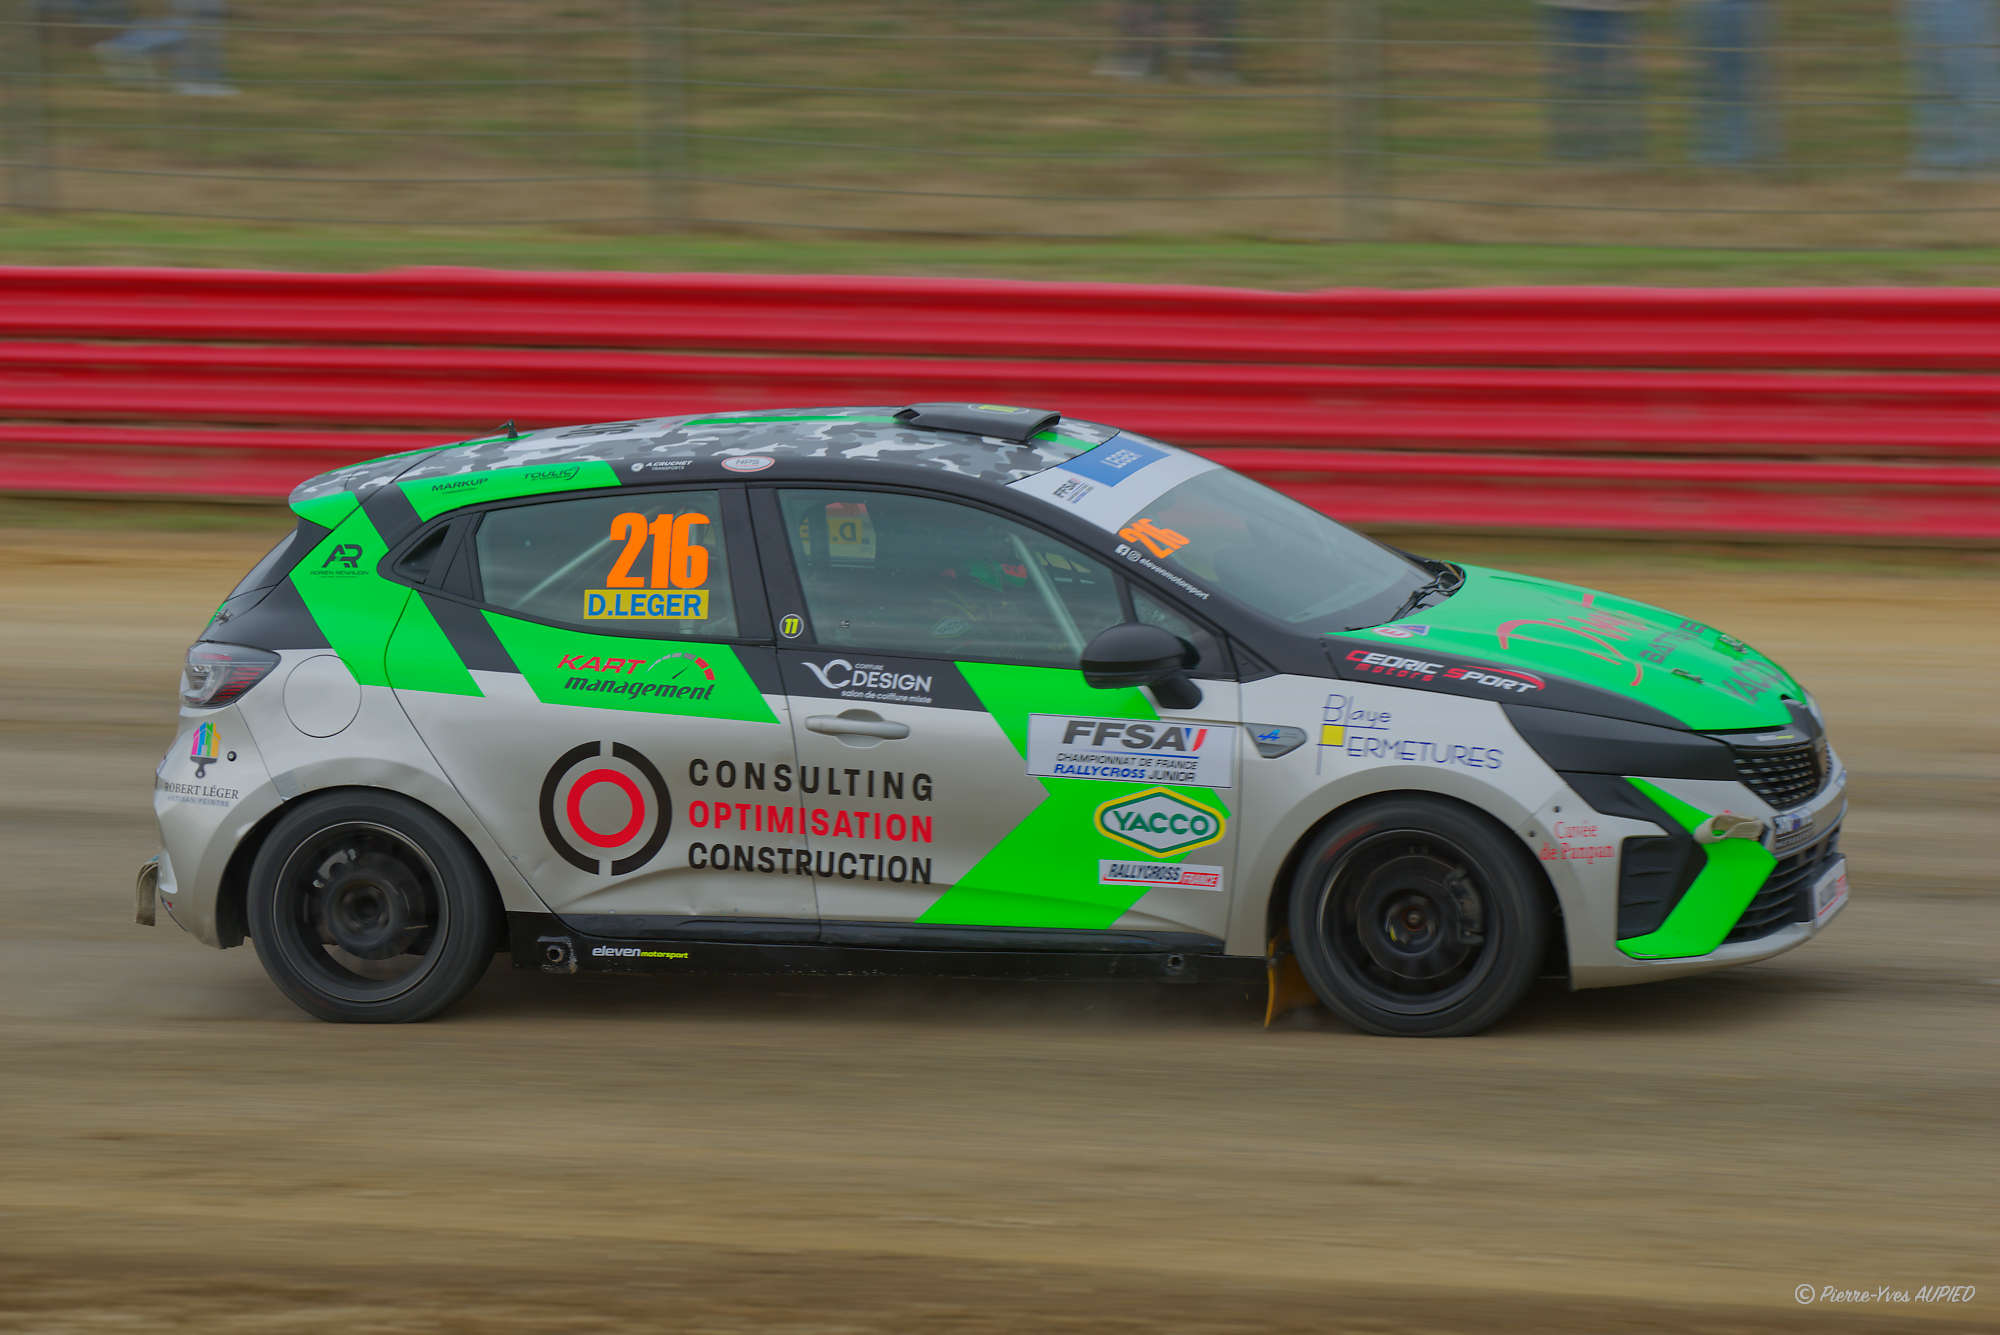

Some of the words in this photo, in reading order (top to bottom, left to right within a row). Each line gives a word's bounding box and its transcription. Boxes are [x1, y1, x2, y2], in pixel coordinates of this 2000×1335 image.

[431, 477, 489, 492] MARKUP
[606, 512, 711, 589] 216
[1118, 518, 1191, 559] 216
[321, 544, 363, 568] AR
[588, 594, 701, 617] D.LEGER
[784, 618, 799, 635] 11
[557, 654, 647, 675] KART
[1345, 650, 1444, 674] CEDRIC
[1443, 668, 1538, 693] SPORT
[1354, 663, 1434, 682] motors
[564, 676, 716, 700] management
[851, 670, 933, 692] DESIGN
[865, 691, 876, 699] de
[1322, 694, 1392, 729] Blaye
[1062, 720, 1186, 752] FFSA
[1054, 764, 1146, 778] RALLYCROSS
[1147, 770, 1196, 782] JUNIOR
[1056, 752, 1136, 765] CHAMPIONNAT
[1139, 757, 1153, 767] DE
[1154, 759, 1198, 771] FRANCE
[689, 758, 933, 801] CONSULTING
[203, 785, 239, 799] LÉGER
[689, 800, 933, 843] OPTIMISATION
[1112, 810, 1209, 836] YACCO
[688, 842, 932, 885] CONSTRUCTION
